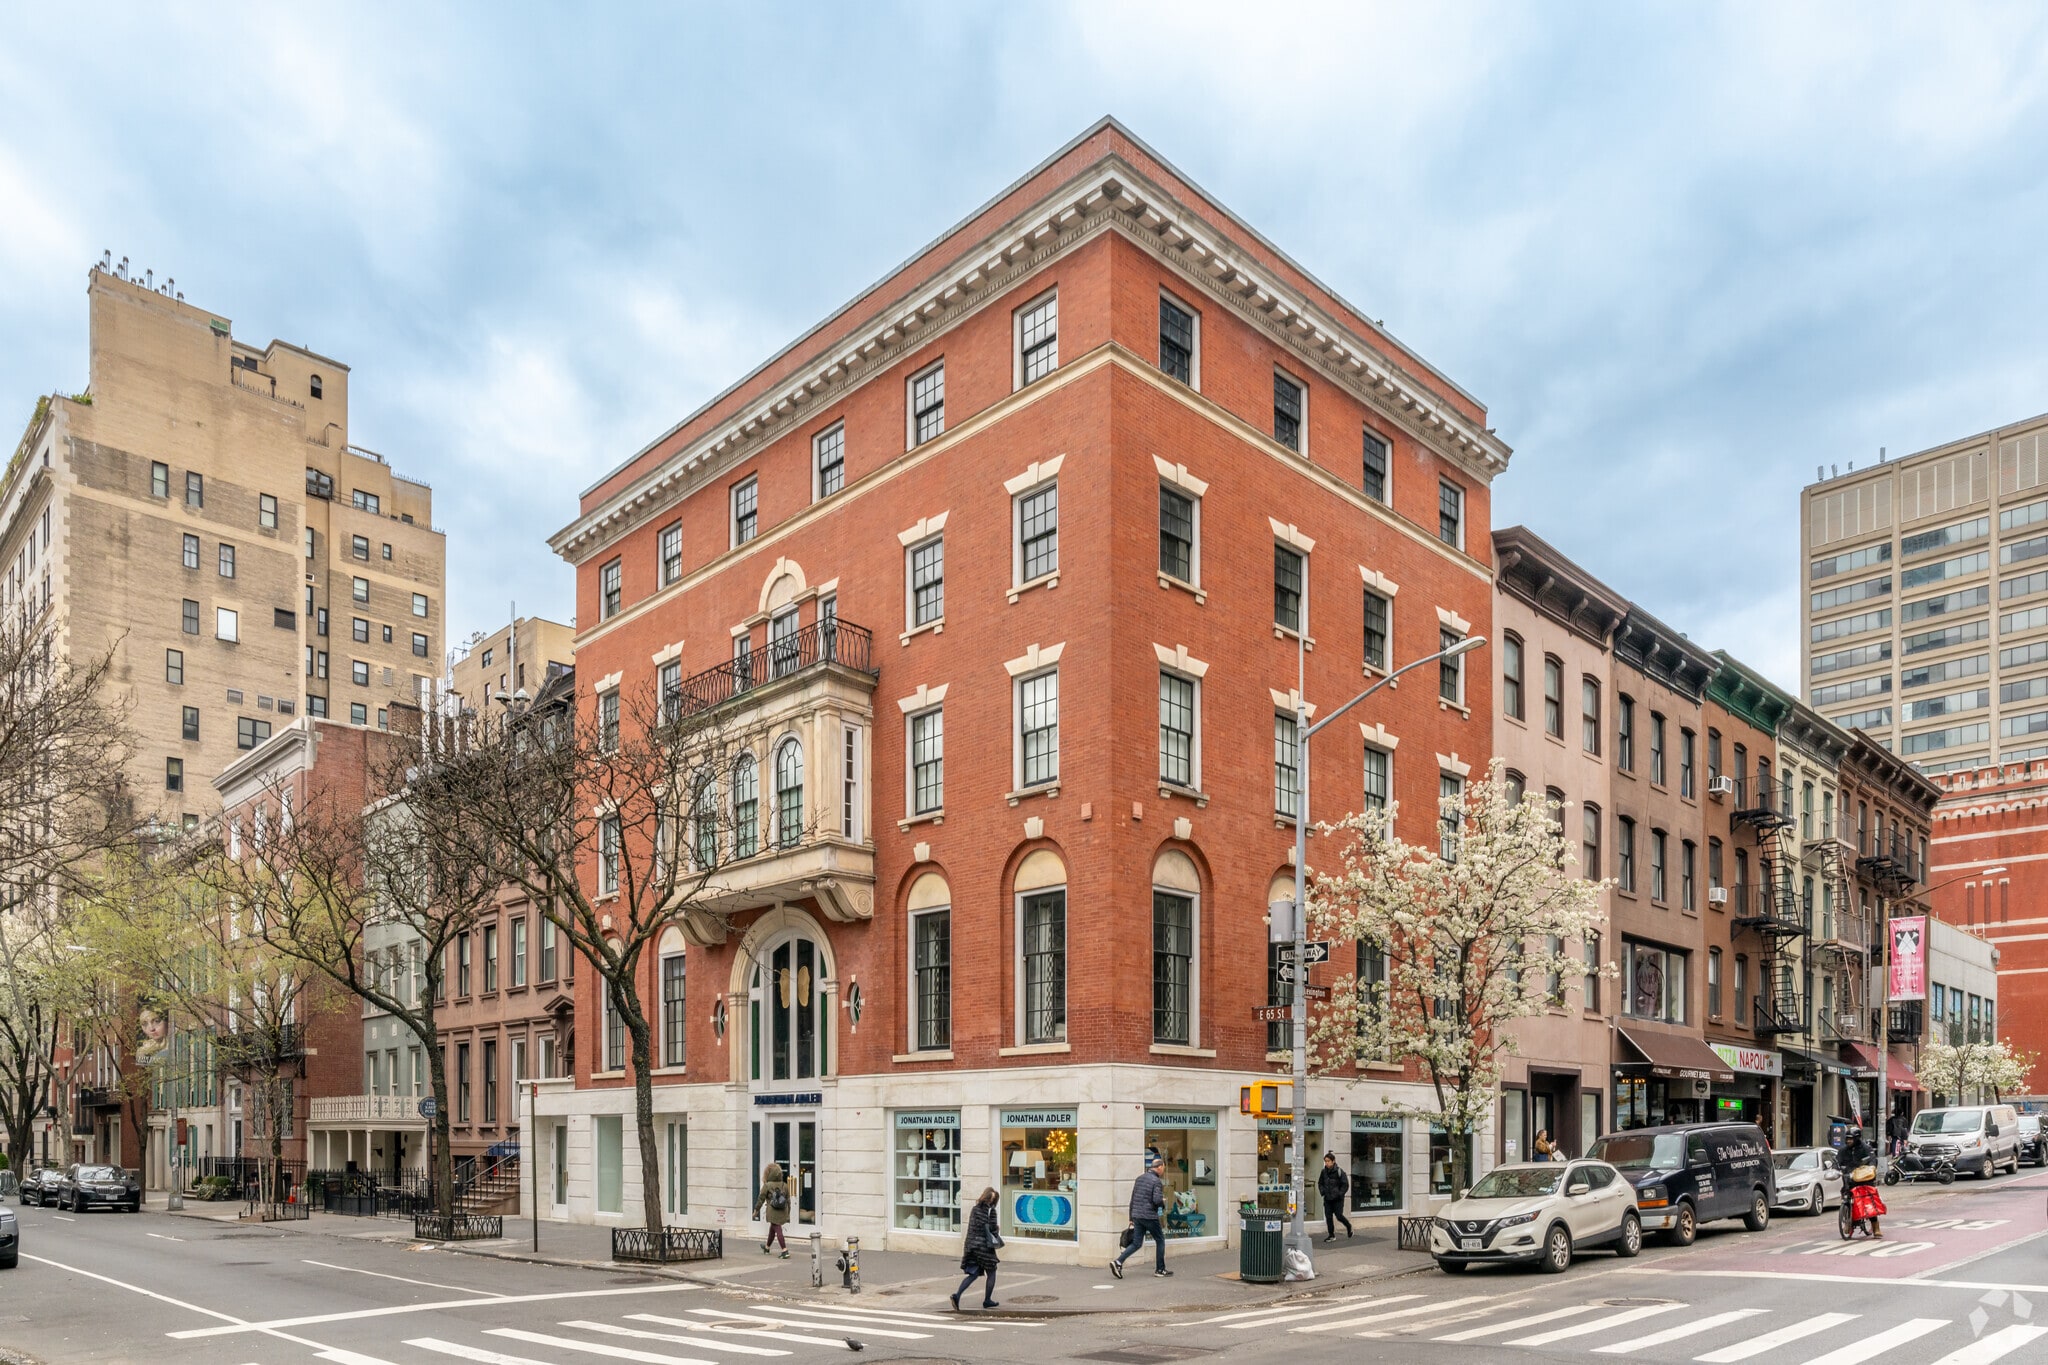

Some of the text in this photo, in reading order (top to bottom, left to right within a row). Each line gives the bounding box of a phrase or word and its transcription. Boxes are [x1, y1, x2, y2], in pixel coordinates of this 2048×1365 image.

[1306, 949, 1321, 958] WAY
[1282, 969, 1292, 978] ONE
[1260, 1008, 1284, 1019] E 65 St
[1740, 1050, 1766, 1071] NAPOLI
[1680, 1069, 1699, 1079] GOURMET
[900, 1116, 955, 1125] JONATHAN ADLER
[1006, 1113, 1071, 1123] JONATHAN ADLER
[1151, 1115, 1211, 1125] JONATHAN ADLER
[1266, 1117, 1293, 1126] JONATHA
[1355, 1120, 1397, 1129] JONATHAN ADLER
